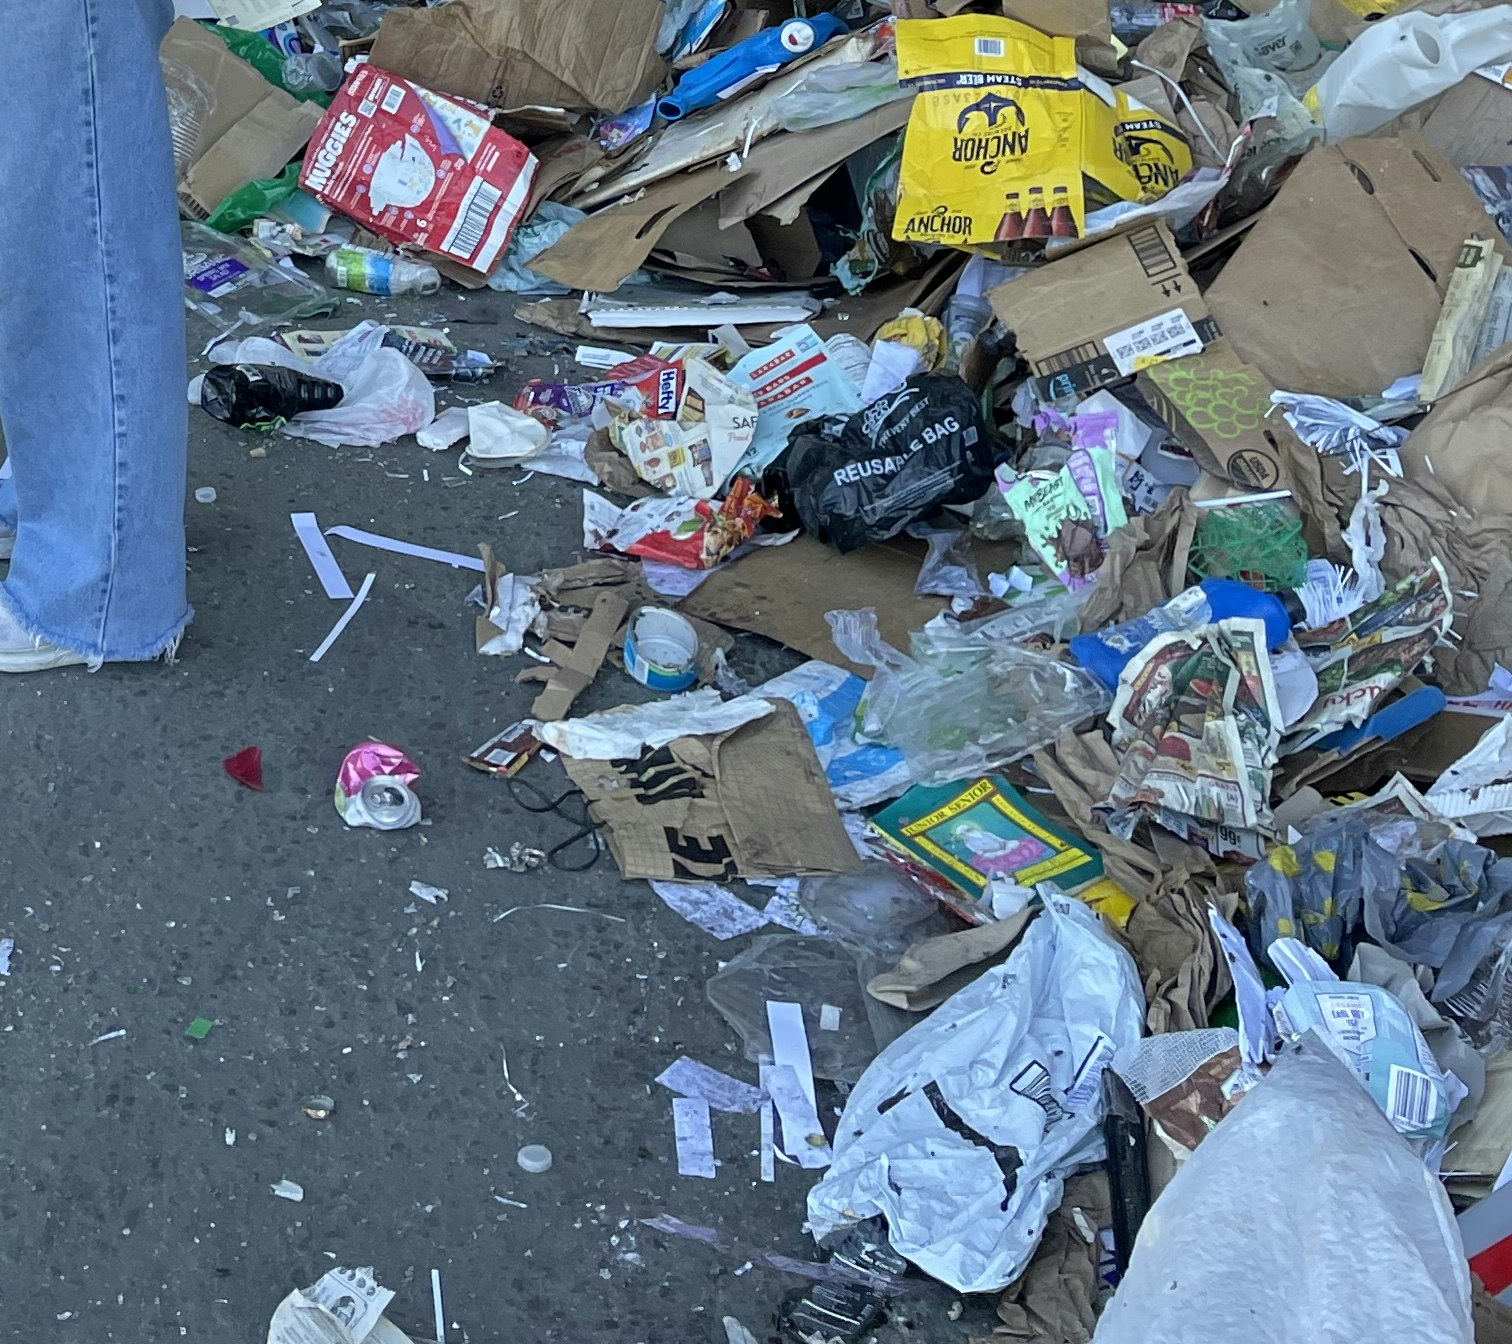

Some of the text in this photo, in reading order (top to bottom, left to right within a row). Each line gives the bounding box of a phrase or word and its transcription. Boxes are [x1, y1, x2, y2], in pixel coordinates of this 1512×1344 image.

[985, 74, 1022, 87] STEAM
[1122, 118, 1163, 132] STEAM
[300, 111, 358, 193] HUGGIES
[952, 127, 1030, 162] ANCHOR
[904, 214, 973, 236] ANCHOR
[658, 370, 676, 411] Hefty
[923, 415, 961, 448] BAG
[904, 778, 993, 839] JUNIOR SENIOR
